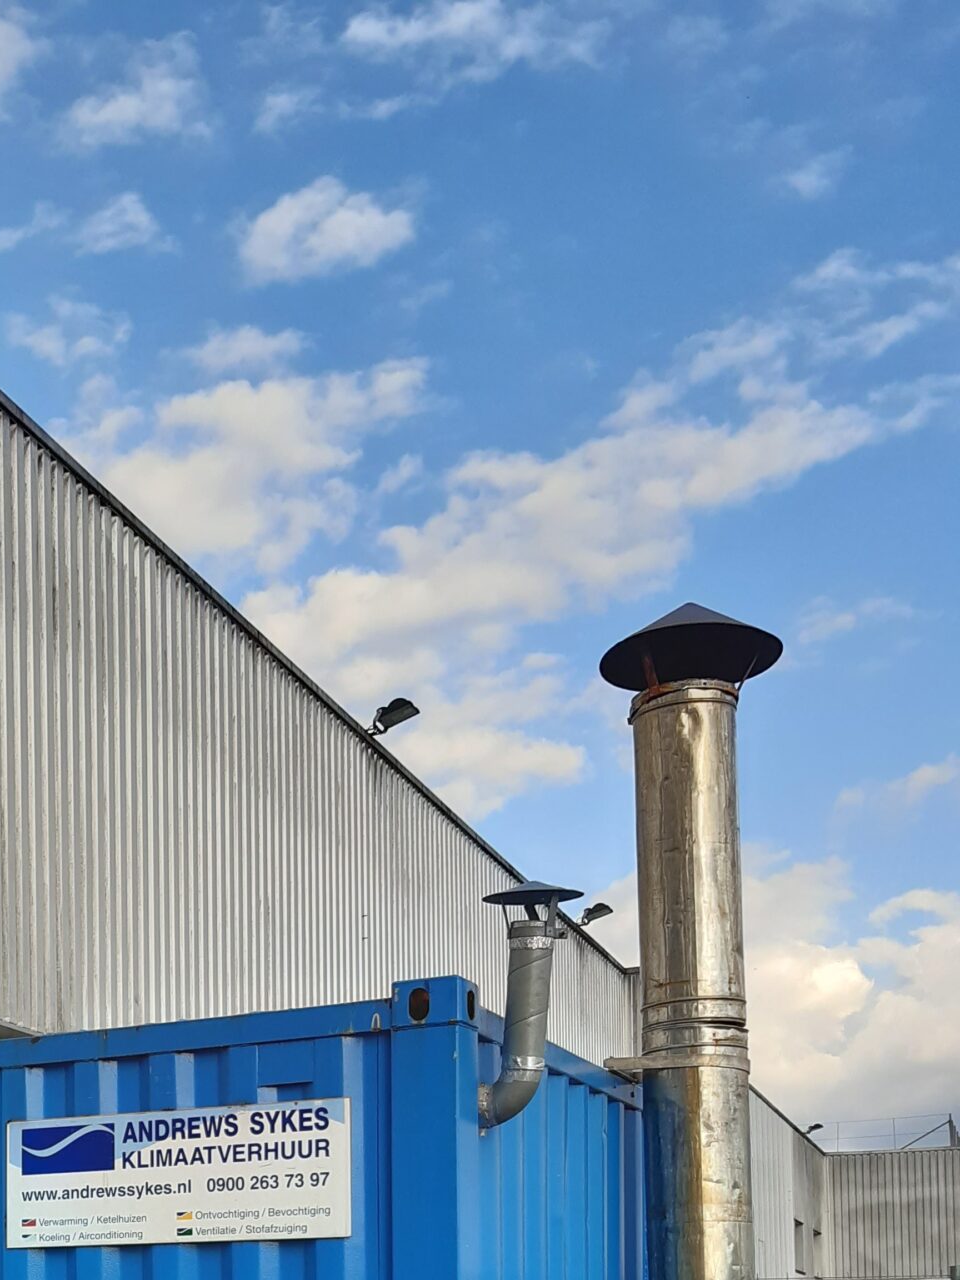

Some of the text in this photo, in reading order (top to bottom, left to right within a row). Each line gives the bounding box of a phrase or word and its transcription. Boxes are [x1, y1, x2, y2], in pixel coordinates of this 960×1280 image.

[122, 1107, 330, 1144] ANDREWS SYKES
[122, 1139, 330, 1169] KLIMAATVERHUUR
[21, 1171, 330, 1202] www.andrewssykes.nl 0900 263 73 97
[38, 1216, 89, 1228] Verwarming
[96, 1214, 147, 1225] Ketelhuizen
[195, 1208, 260, 1221] Ontvochtiging
[268, 1205, 331, 1218] Bevochtiging
[38, 1232, 71, 1243] Koeling
[79, 1230, 143, 1241] Airconditioning
[195, 1224, 237, 1236] Ventilatie
[245, 1223, 308, 1235] Stofafzuiging
